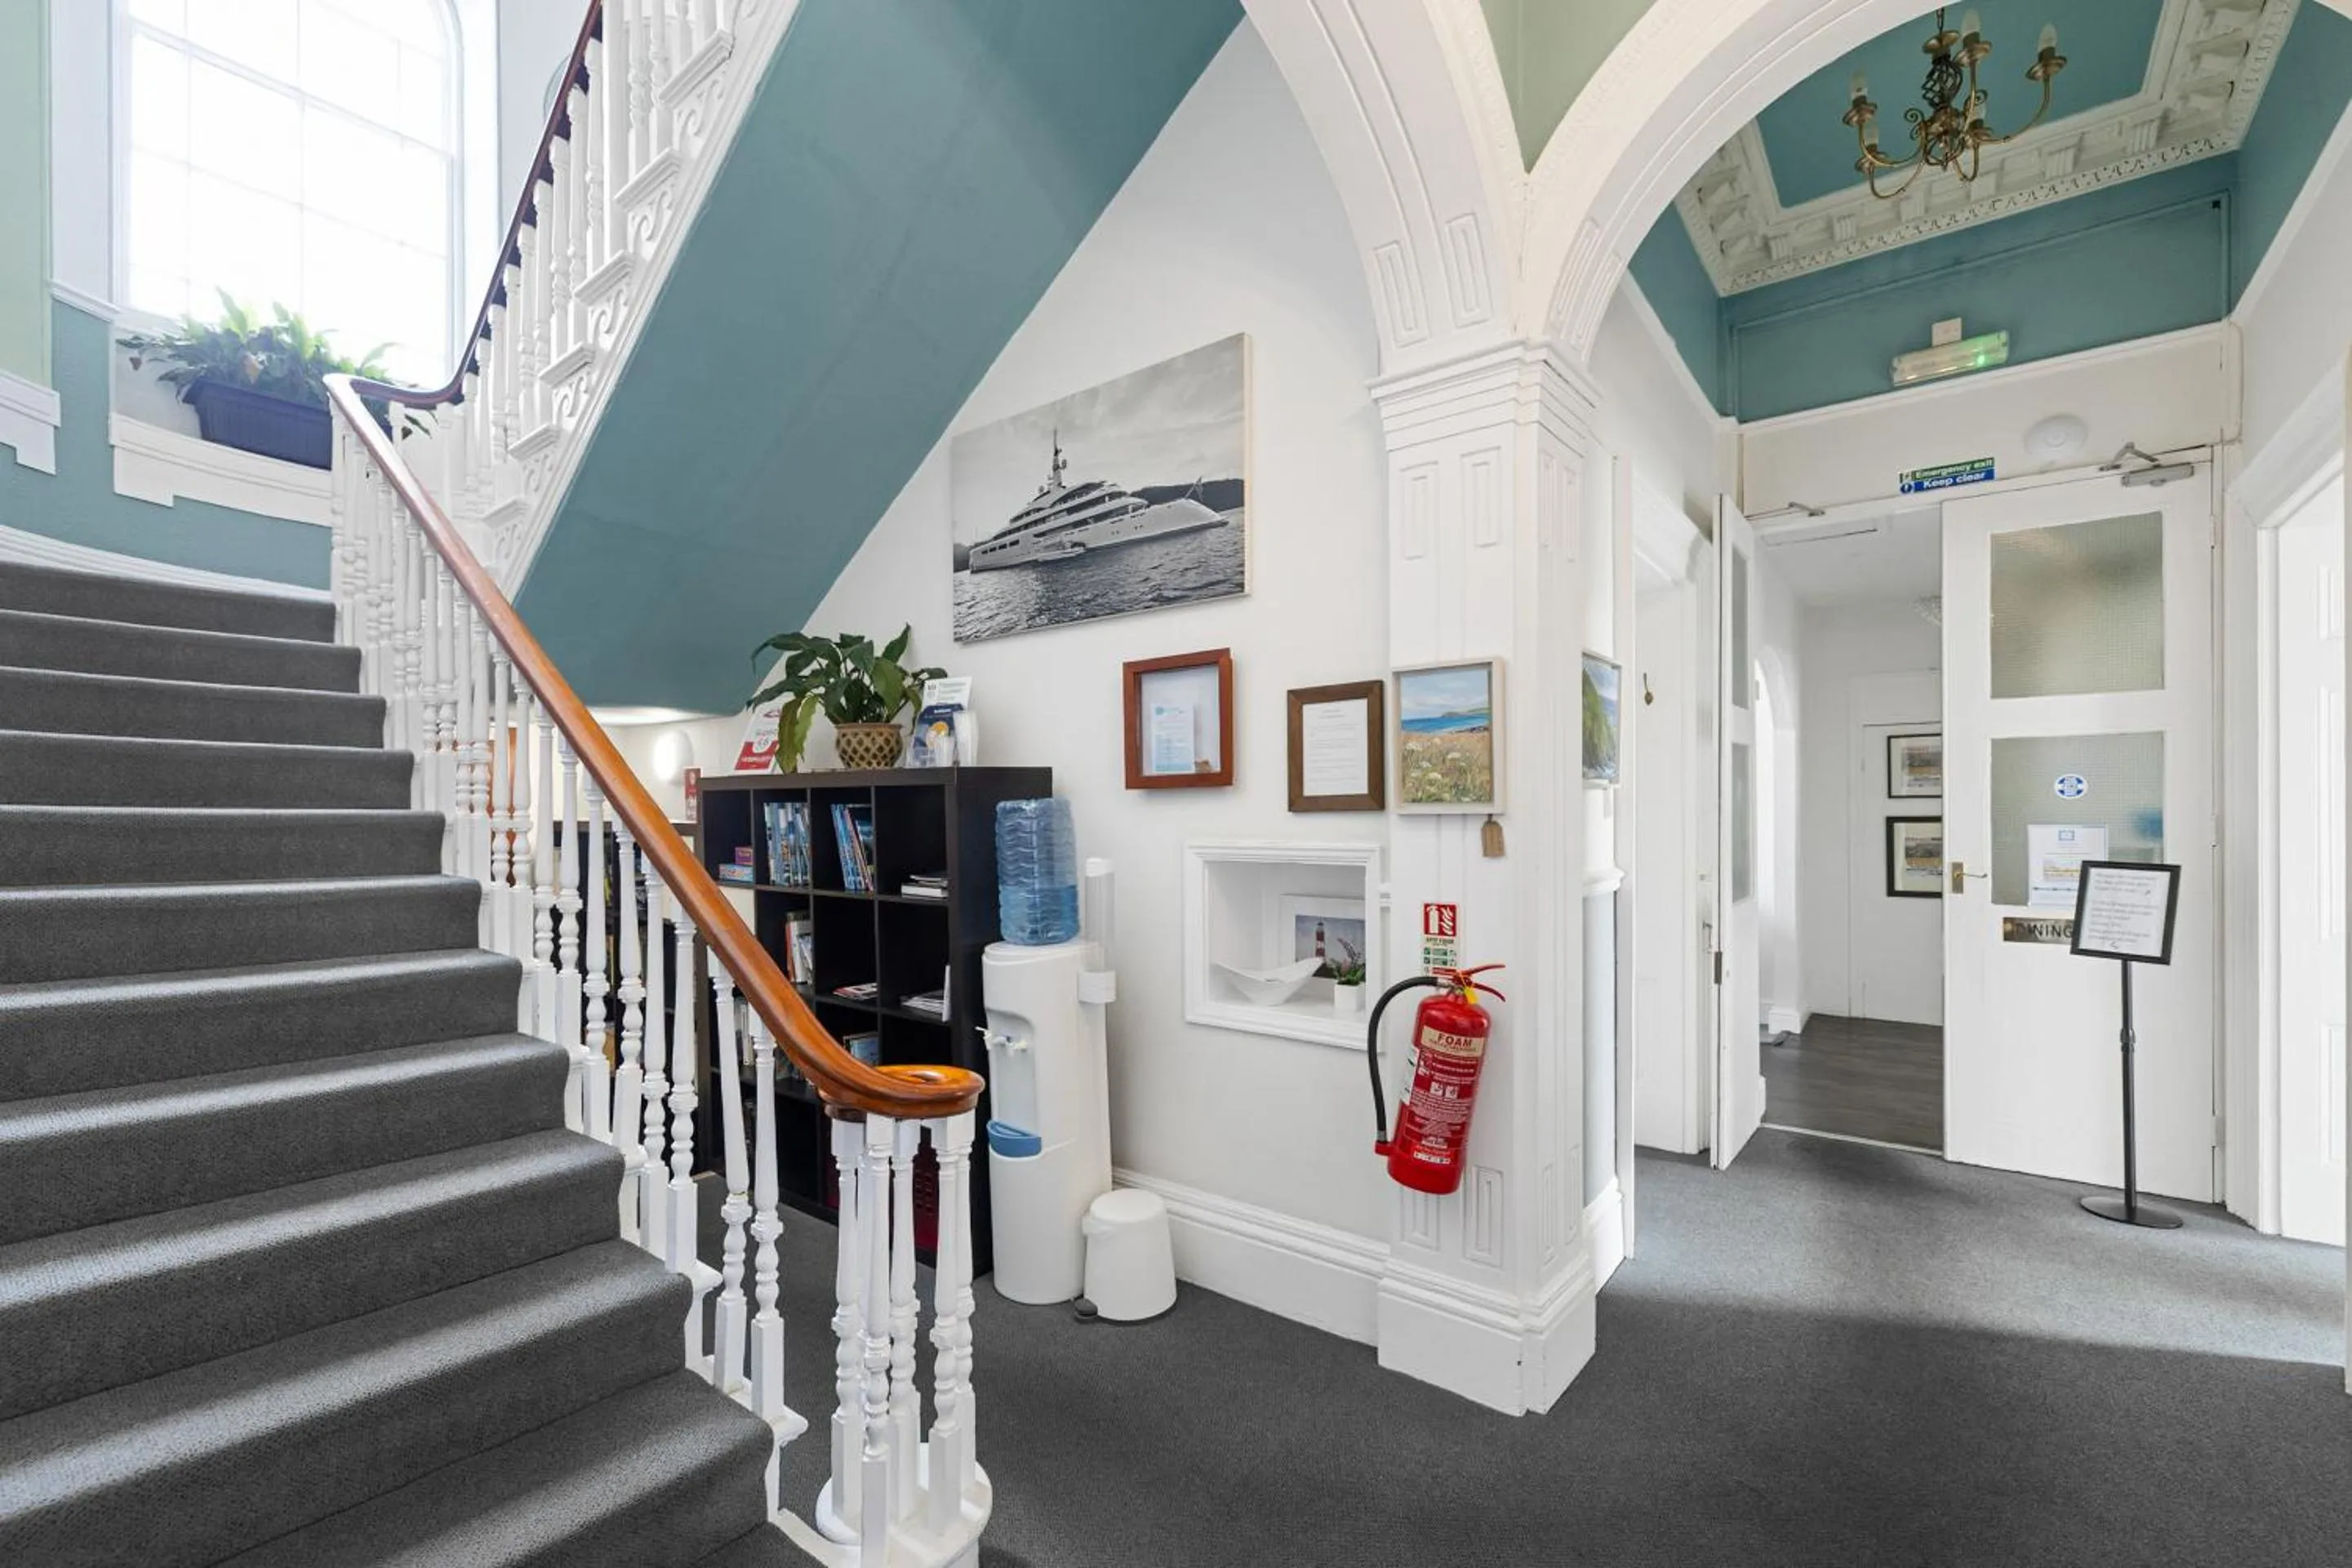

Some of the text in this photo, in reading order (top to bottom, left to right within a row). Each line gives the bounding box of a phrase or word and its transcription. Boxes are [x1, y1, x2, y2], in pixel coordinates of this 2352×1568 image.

[1915, 460, 1992, 479] Emergency exit
[1923, 472, 1986, 489] Keep clear
[1438, 1033, 1474, 1046] FOAM
